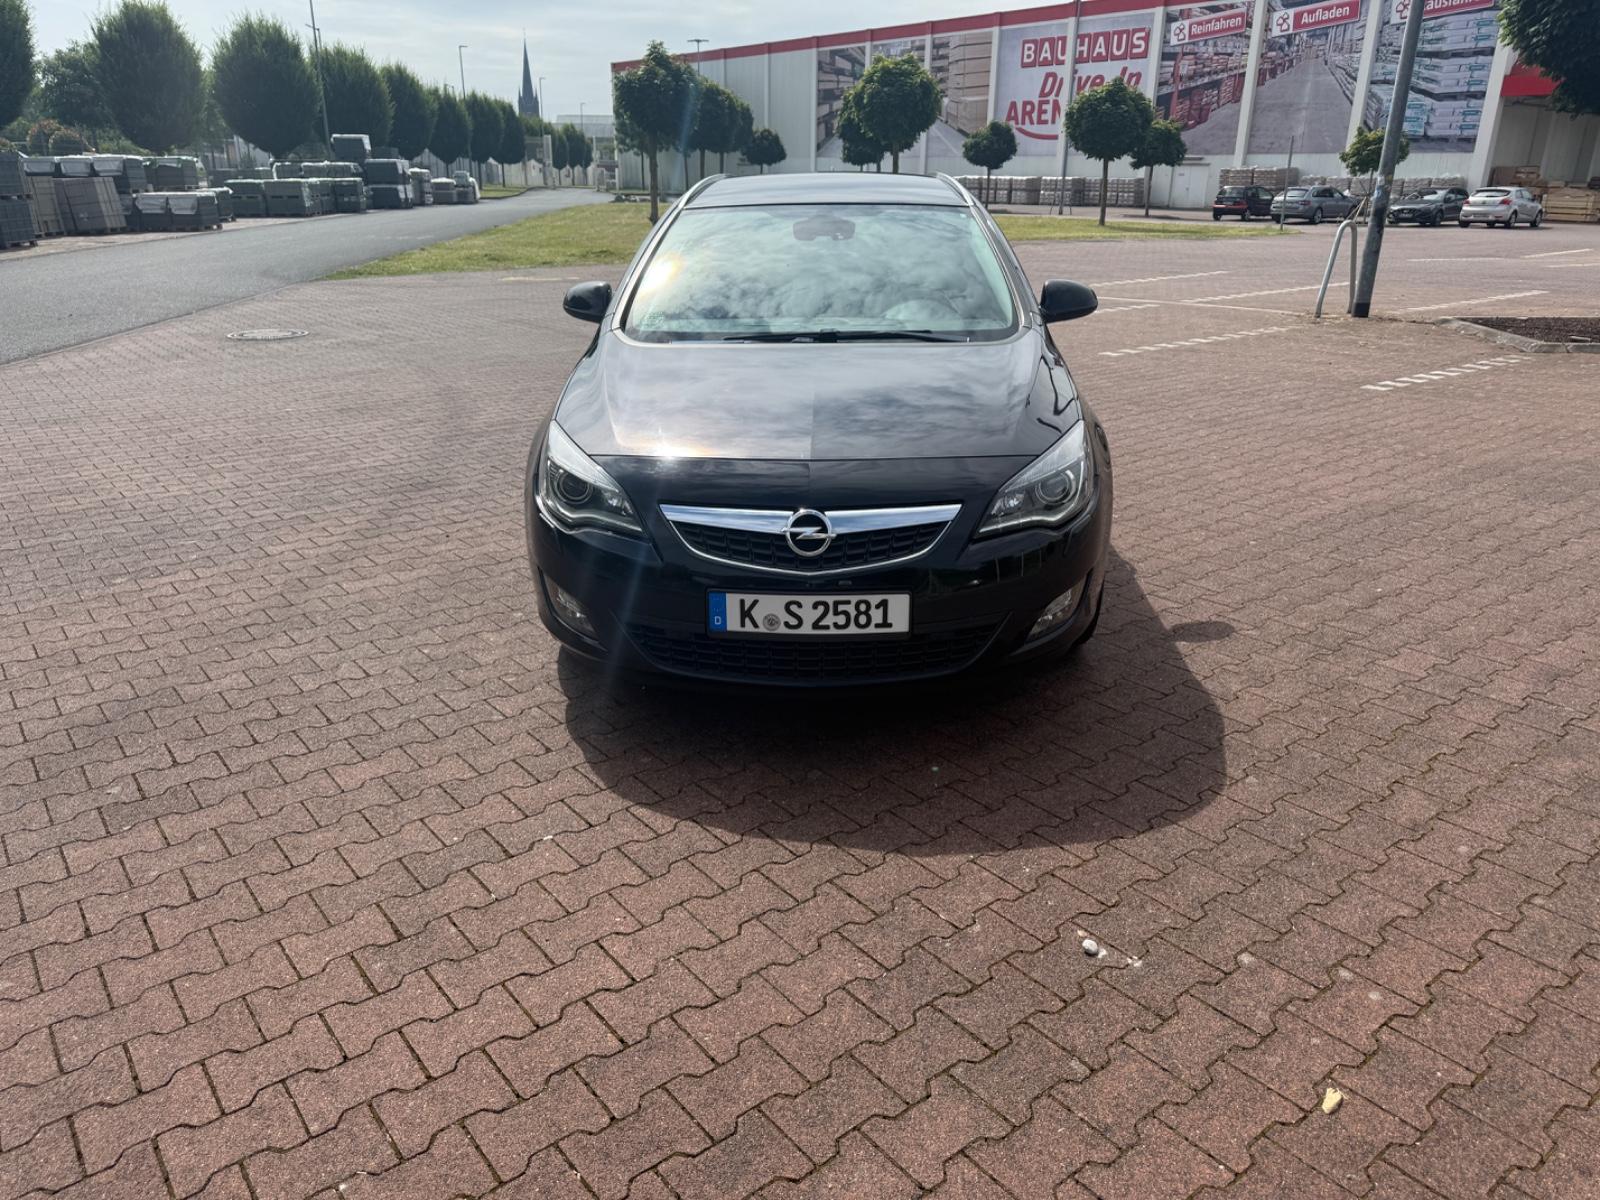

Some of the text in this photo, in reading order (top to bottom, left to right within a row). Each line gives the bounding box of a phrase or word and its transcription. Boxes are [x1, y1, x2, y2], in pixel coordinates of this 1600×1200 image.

[1191, 17, 1242, 36] Reinfahren
[1301, 6, 1350, 25] Aufladen
[1022, 30, 1148, 64] BAUHAUS
[1005, 99, 1062, 126] AREN
[714, 615, 722, 625] D
[739, 598, 759, 629] K
[783, 600, 803, 630] S
[812, 599, 893, 630] 2581
